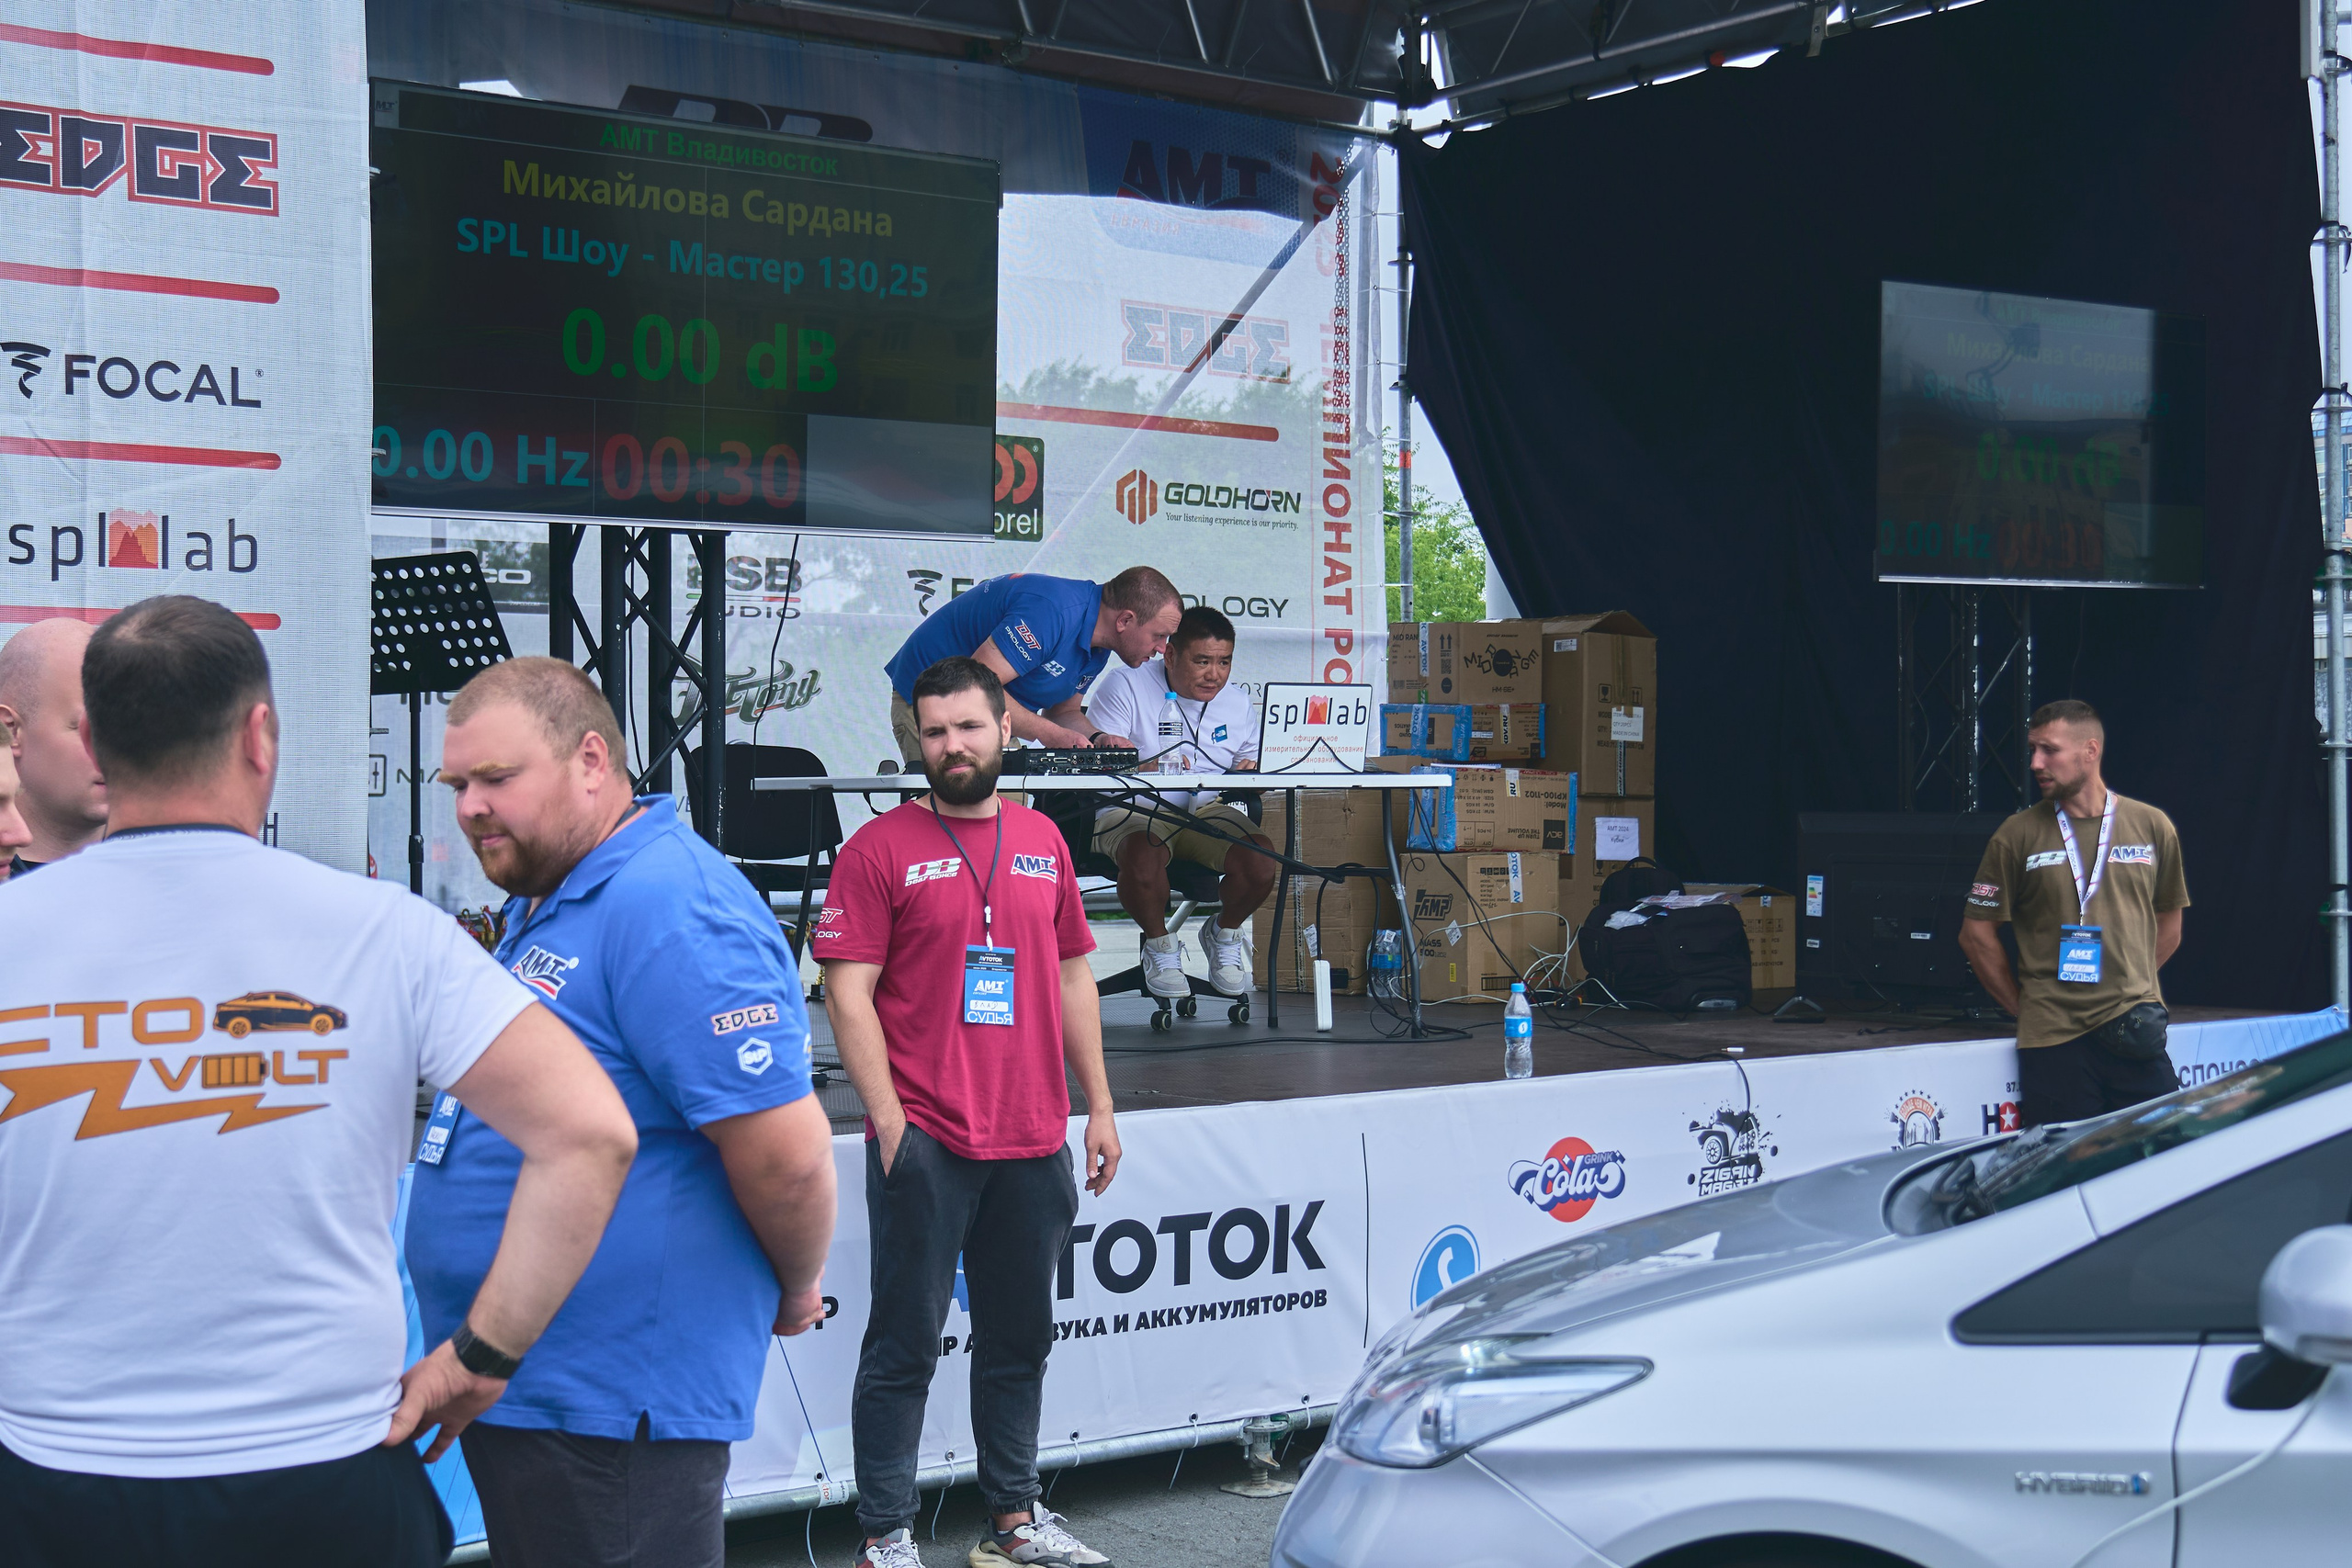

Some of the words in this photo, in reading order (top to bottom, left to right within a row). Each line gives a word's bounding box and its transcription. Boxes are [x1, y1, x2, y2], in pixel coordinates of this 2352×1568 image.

[0, 100, 279, 217] EDGE
[667, 131, 839, 175] Владивосток
[503, 159, 729, 219] Михайлова
[741, 188, 894, 239] Сардана
[457, 217, 528, 258] SPL
[541, 225, 630, 276] Шоу
[669, 239, 806, 294] Мастер
[818, 254, 929, 300] 130,25
[561, 307, 722, 387] 0.00
[745, 323, 841, 394] dB
[1120, 299, 1291, 384] EDGE
[64, 354, 262, 409] FOCAL
[369, 424, 494, 482] 0.00
[516, 434, 591, 488] Hz
[601, 432, 801, 508] 00:30
[1163, 481, 1302, 514] GOLDHORN
[1165, 512, 1183, 522] Your
[1183, 513, 1214, 526] listening
[1215, 516, 1250, 527] experience
[1251, 518, 1258, 527] is
[1259, 519, 1270, 528] our
[1272, 518, 1299, 532] priority.
[1004, 626, 1033, 661] PROLOGY
[1014, 619, 1042, 650] DST
[1264, 745, 1316, 754] измерительно
[1293, 734, 1339, 744] официаьное
[1290, 756, 1337, 764] совнований
[1524, 790, 1567, 800] KP100-1102
[1012, 853, 1056, 877] AMT
[2109, 844, 2152, 863] AMT
[1419, 939, 1442, 948] MASS
[2059, 971, 2098, 983] СУДЬЯ
[711, 1003, 779, 1035] EDGE
[967, 1010, 1013, 1025] СУДЬЯ
[1525, 1154, 1624, 1207] Cola
[1700, 1163, 1757, 1184] ZIGAN
[1113, 1313, 1129, 1334] И
[1134, 1288, 1329, 1331] АККУМУЛЯТОРОВ
